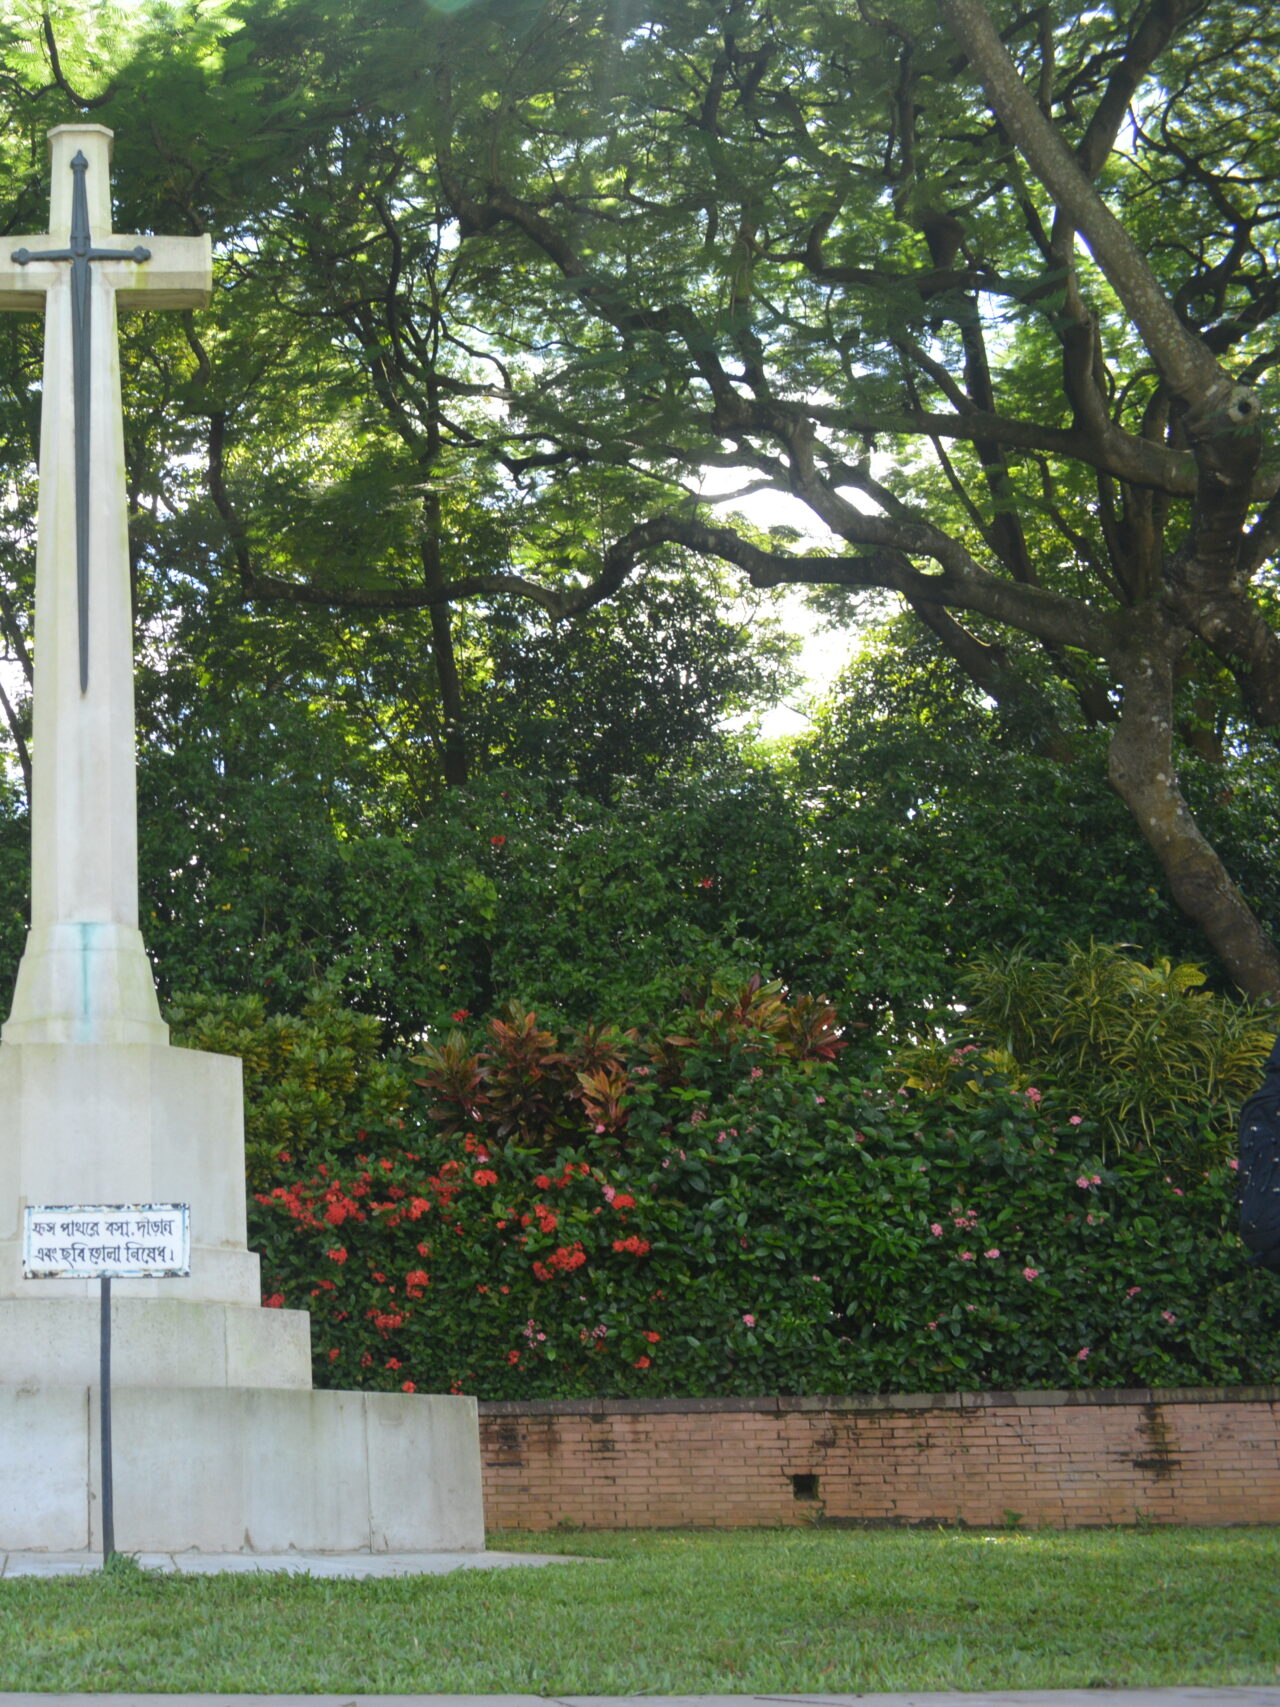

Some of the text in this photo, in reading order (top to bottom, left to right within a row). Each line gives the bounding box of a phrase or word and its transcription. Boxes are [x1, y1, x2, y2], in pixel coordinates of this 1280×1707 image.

[35, 1247, 59, 1263] এবং
[59, 1242, 88, 1269] ছবি
[88, 1245, 121, 1264] তোলা
